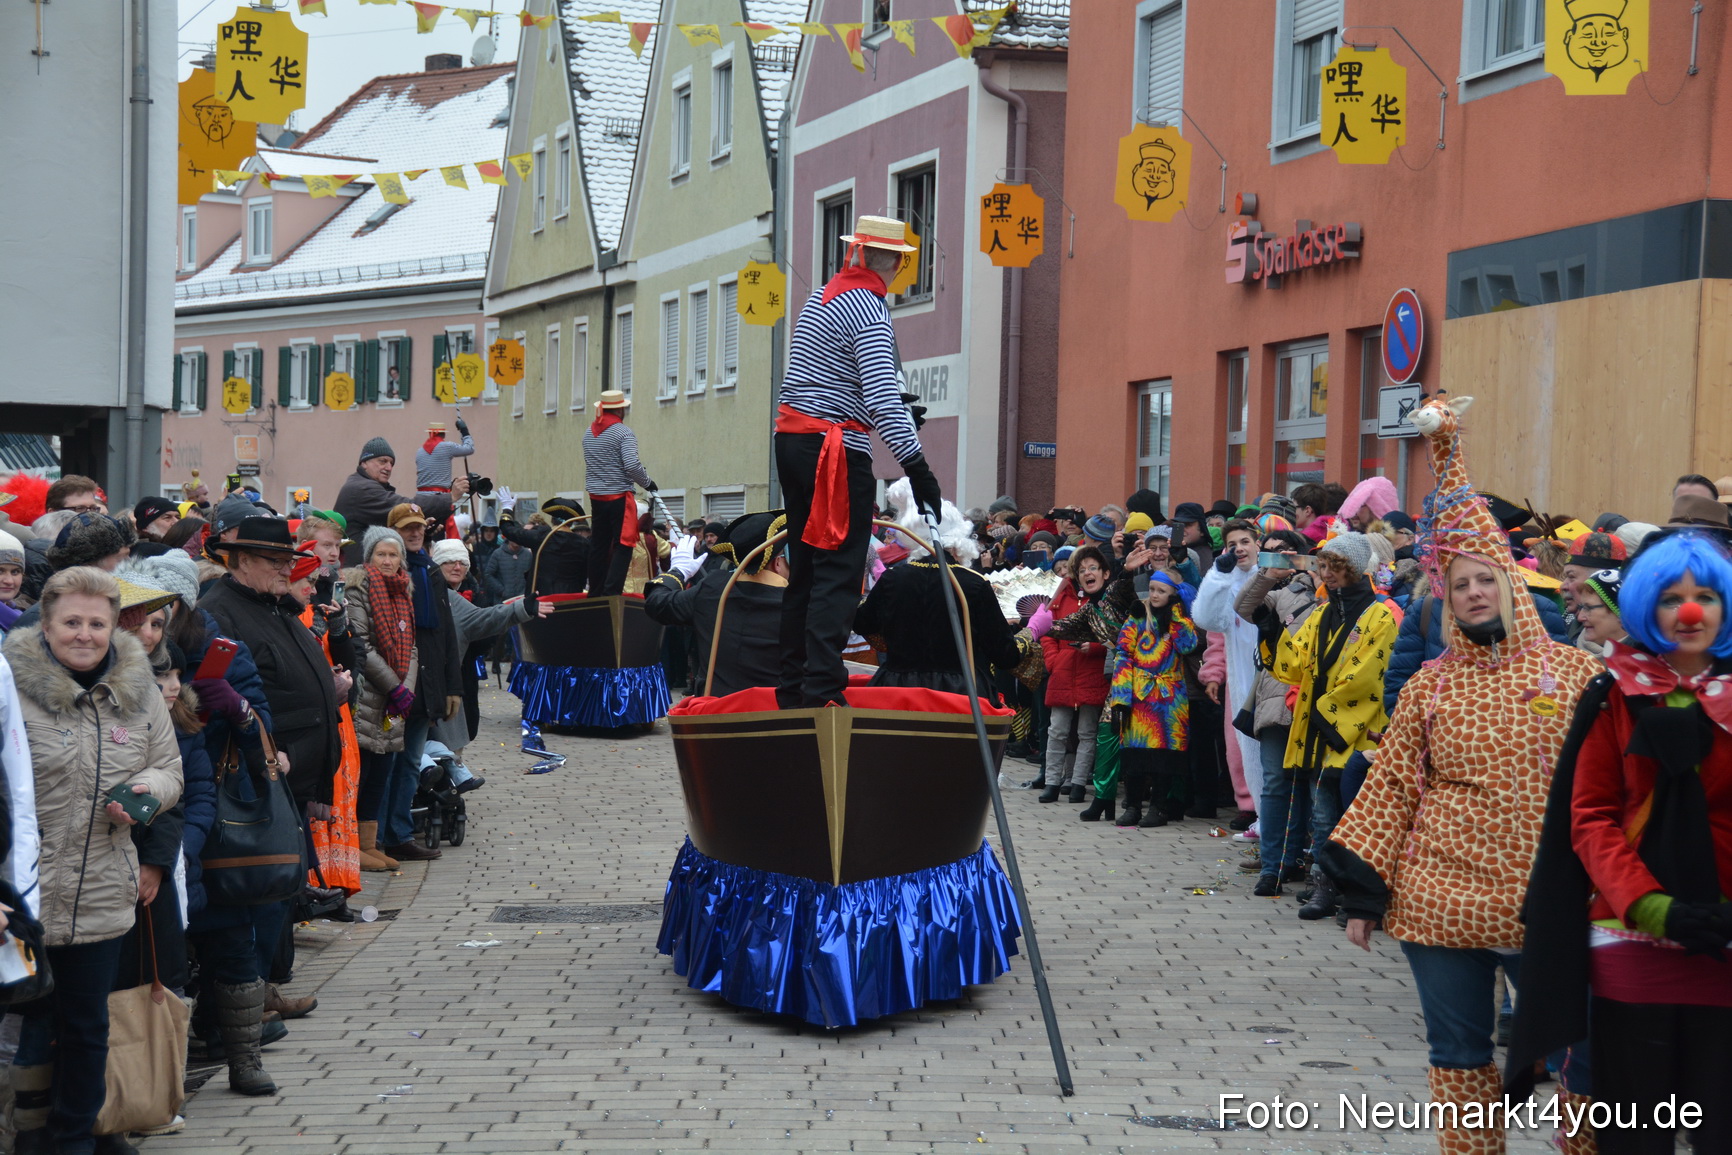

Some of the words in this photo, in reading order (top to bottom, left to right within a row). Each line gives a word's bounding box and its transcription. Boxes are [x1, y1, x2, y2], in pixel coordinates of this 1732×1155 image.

[269, 56, 302, 95] 华
[1370, 94, 1401, 134] 华
[1017, 216, 1040, 245] 华
[1252, 219, 1347, 289] Sparkasse
